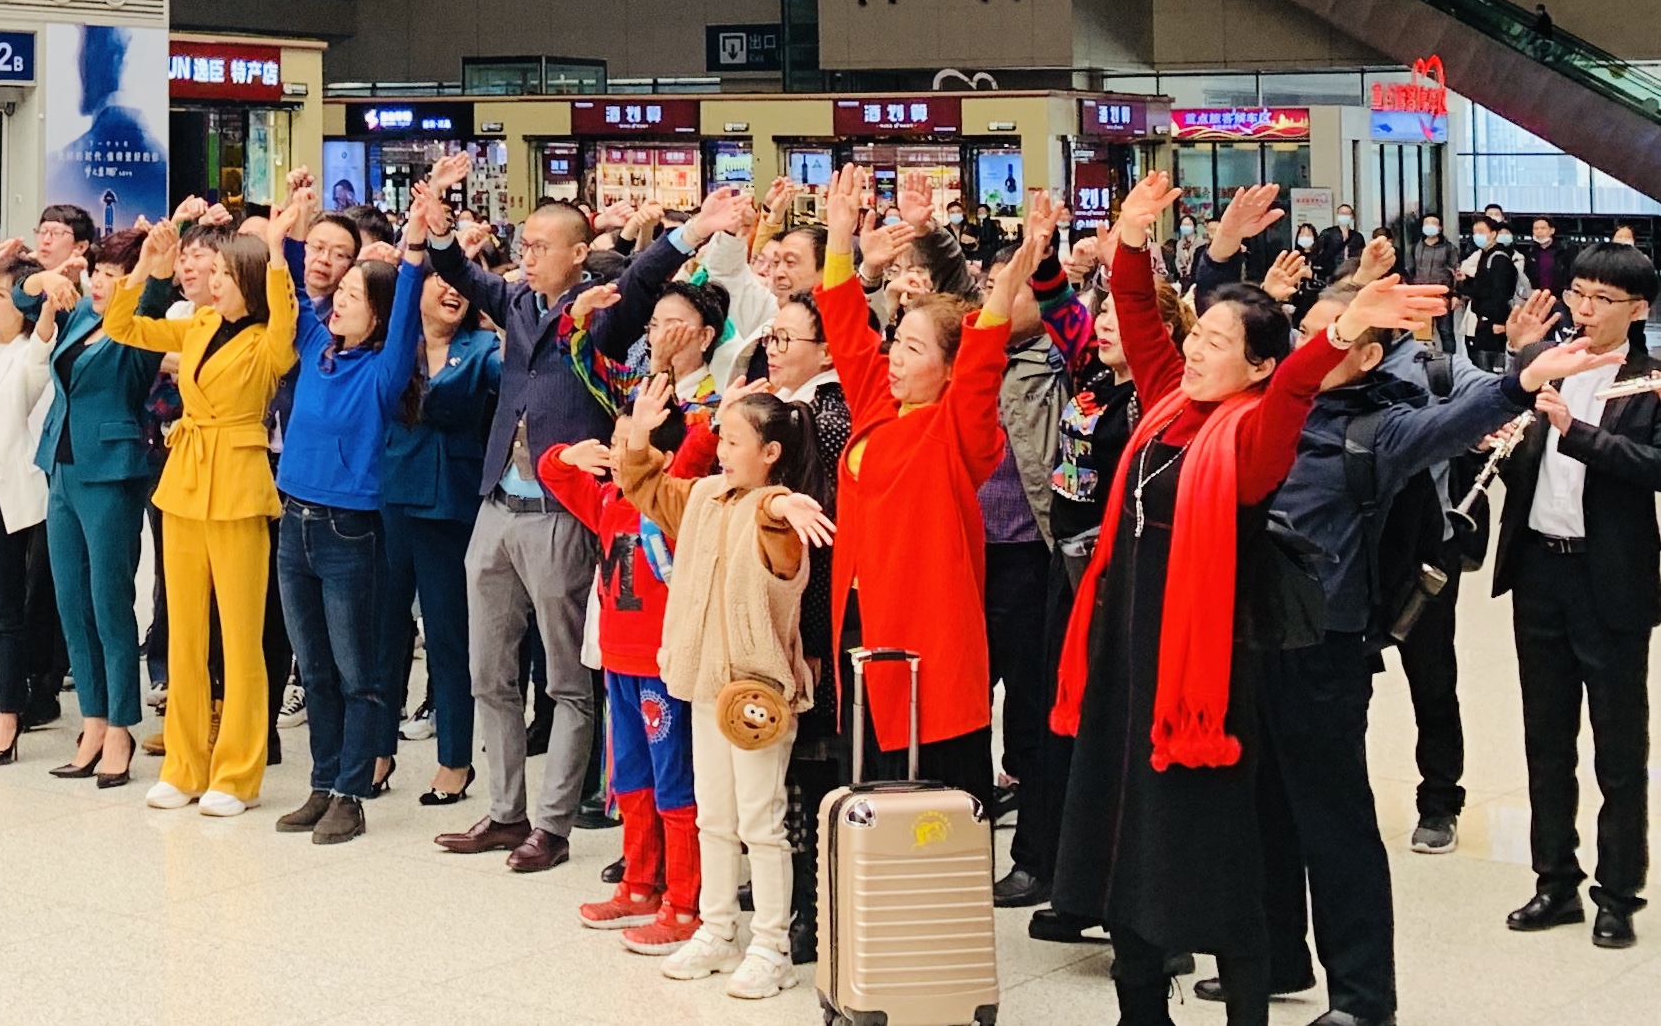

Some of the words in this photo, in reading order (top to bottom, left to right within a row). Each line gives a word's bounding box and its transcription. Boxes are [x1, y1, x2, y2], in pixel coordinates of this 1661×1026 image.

[749, 34, 776, 49] 出口
[230, 59, 279, 86] 特产店
